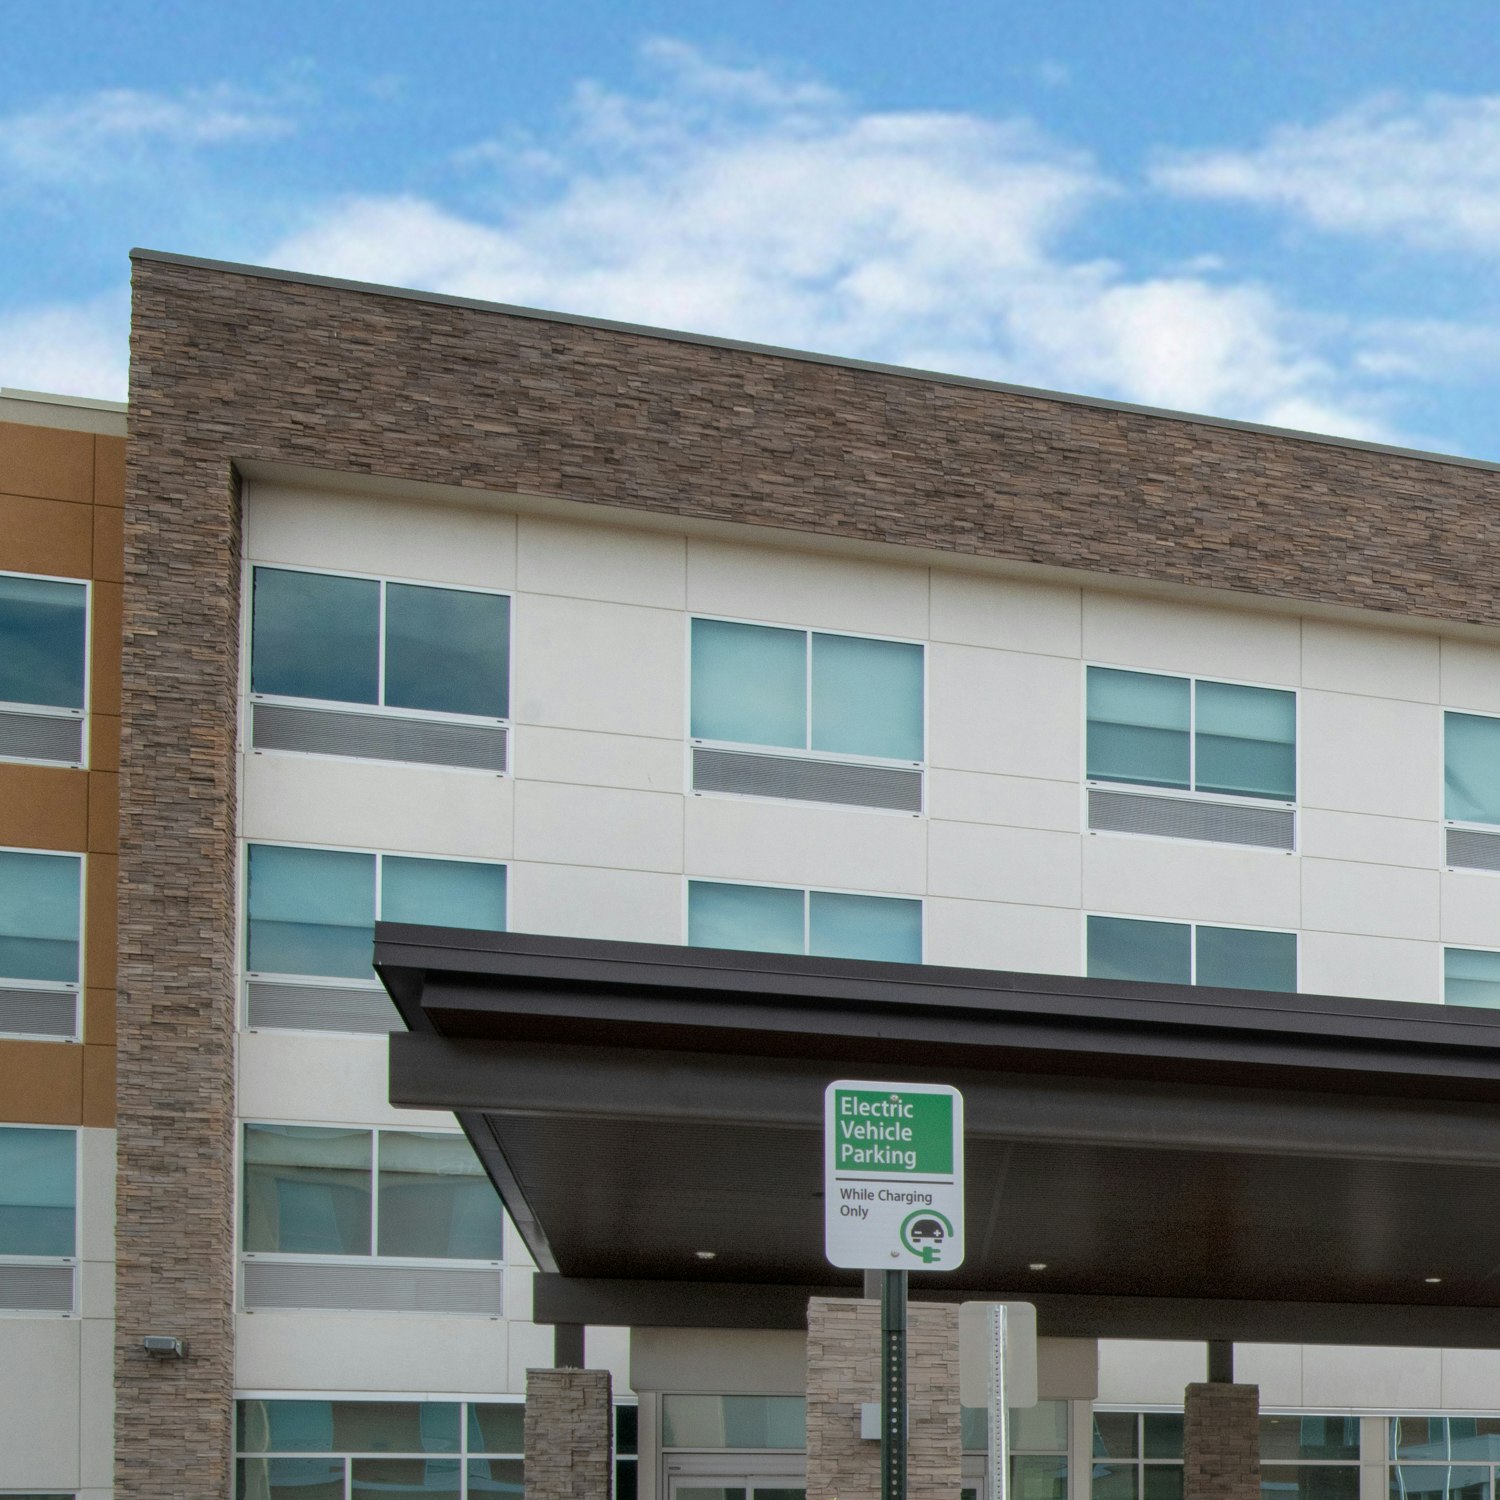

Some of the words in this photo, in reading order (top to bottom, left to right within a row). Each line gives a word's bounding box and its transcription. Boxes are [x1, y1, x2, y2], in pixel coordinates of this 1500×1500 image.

[841, 1096, 914, 1118] Electric
[840, 1120, 913, 1141] Vehicle
[841, 1143, 917, 1170] Parking
[840, 1188, 875, 1201] While
[877, 1189, 933, 1206] Charging
[840, 1205, 869, 1220] Only
